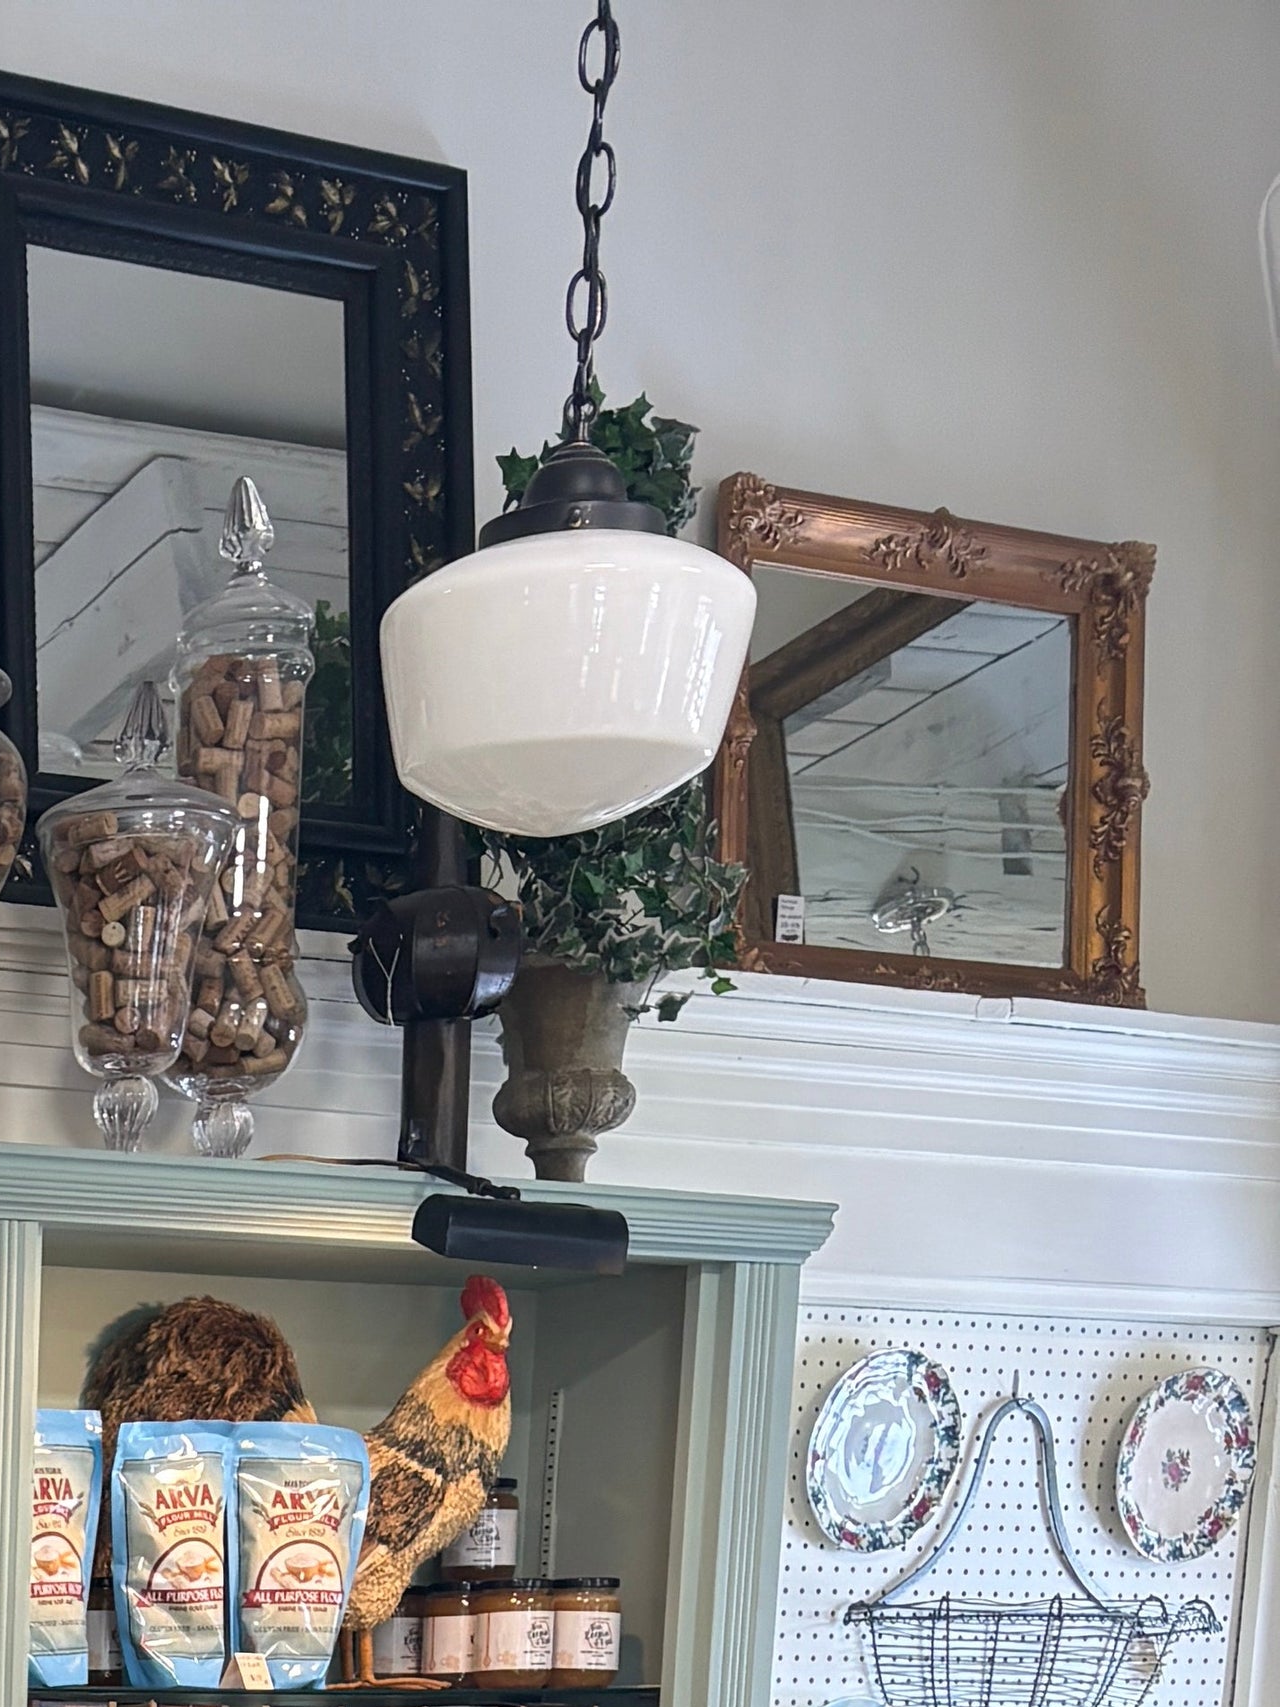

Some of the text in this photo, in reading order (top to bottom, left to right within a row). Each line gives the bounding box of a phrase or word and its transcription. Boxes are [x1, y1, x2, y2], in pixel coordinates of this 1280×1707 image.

[155, 1483, 215, 1511] ARVA
[160, 1511, 216, 1527] FLOUR MILL
[145, 1589, 209, 1602] ALL PURPOSE
[253, 1590, 318, 1602] ALL PURPOSE
